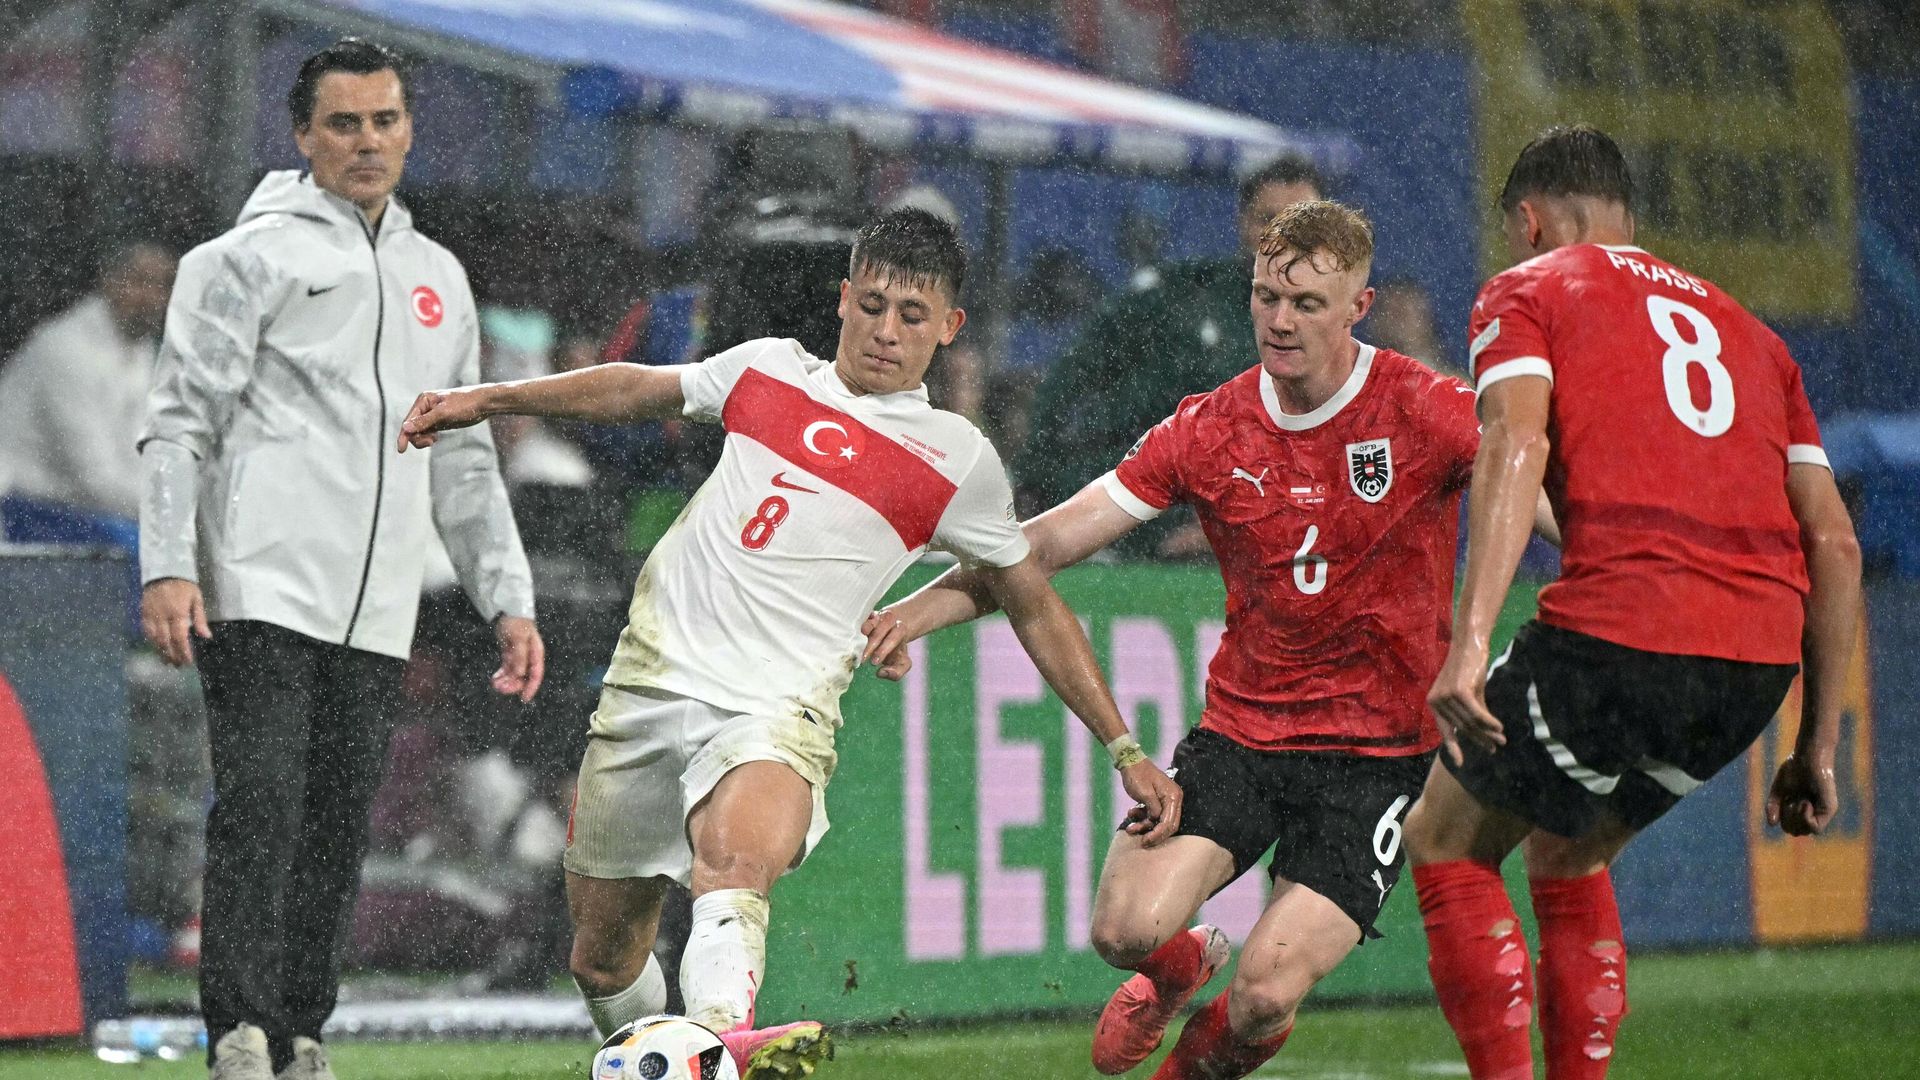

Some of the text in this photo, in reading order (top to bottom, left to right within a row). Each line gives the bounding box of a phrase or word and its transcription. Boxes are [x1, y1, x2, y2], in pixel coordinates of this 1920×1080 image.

[1605, 251, 1707, 298] PRASS
[1646, 294, 1736, 438] 8
[740, 495, 790, 552] 8
[1293, 524, 1328, 595] 6
[1372, 794, 1410, 867] 6
